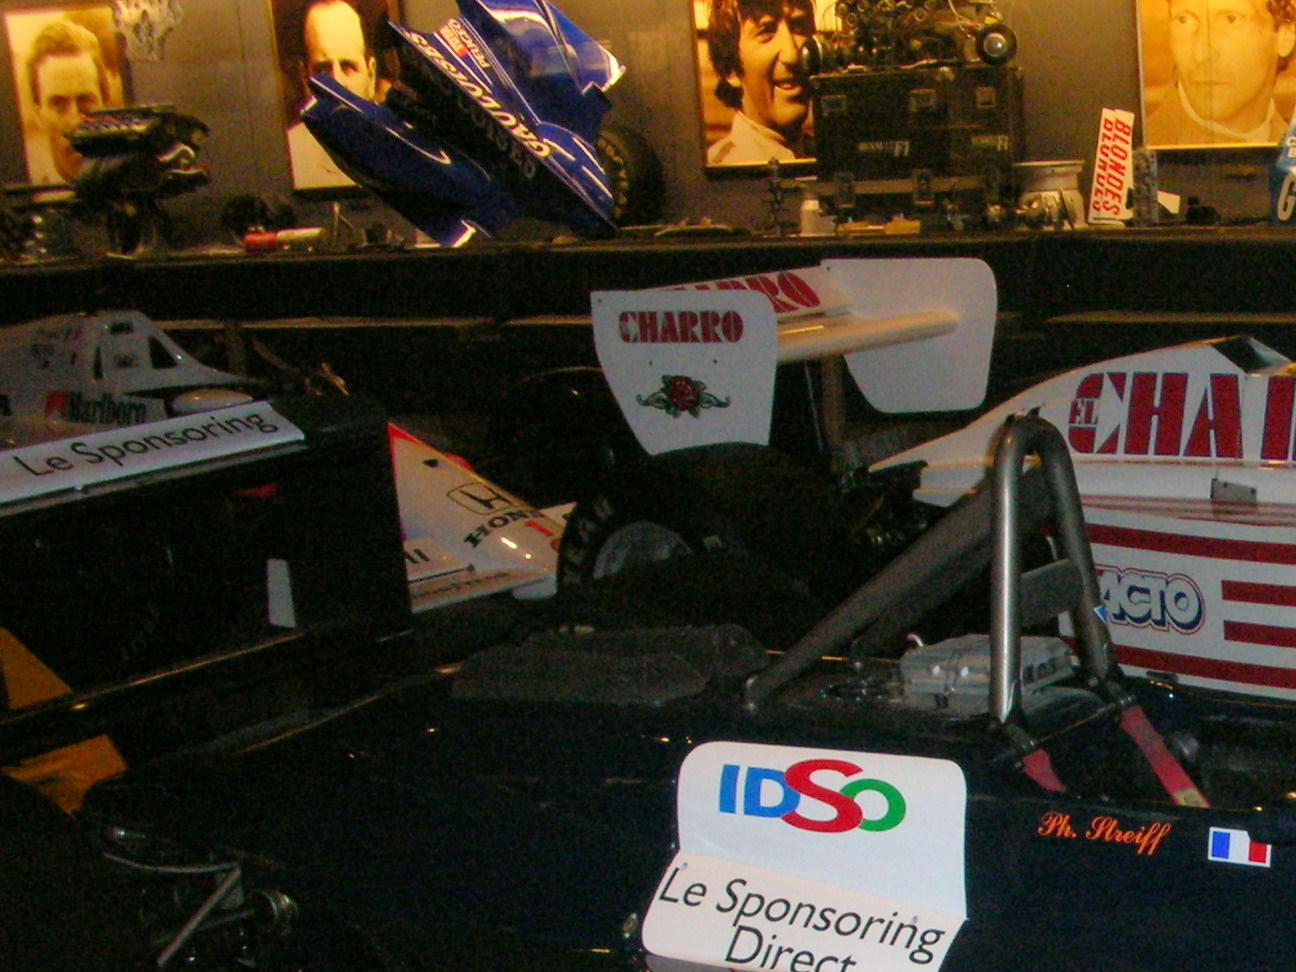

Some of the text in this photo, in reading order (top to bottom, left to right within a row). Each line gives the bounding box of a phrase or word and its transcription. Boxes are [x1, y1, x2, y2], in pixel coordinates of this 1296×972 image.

[1103, 118, 1132, 216] BLONDES
[618, 310, 744, 344] CHARRO
[12, 413, 279, 477] Le Sponsoring
[718, 758, 908, 834] IDSO
[658, 866, 946, 965] Le Sponsoring
